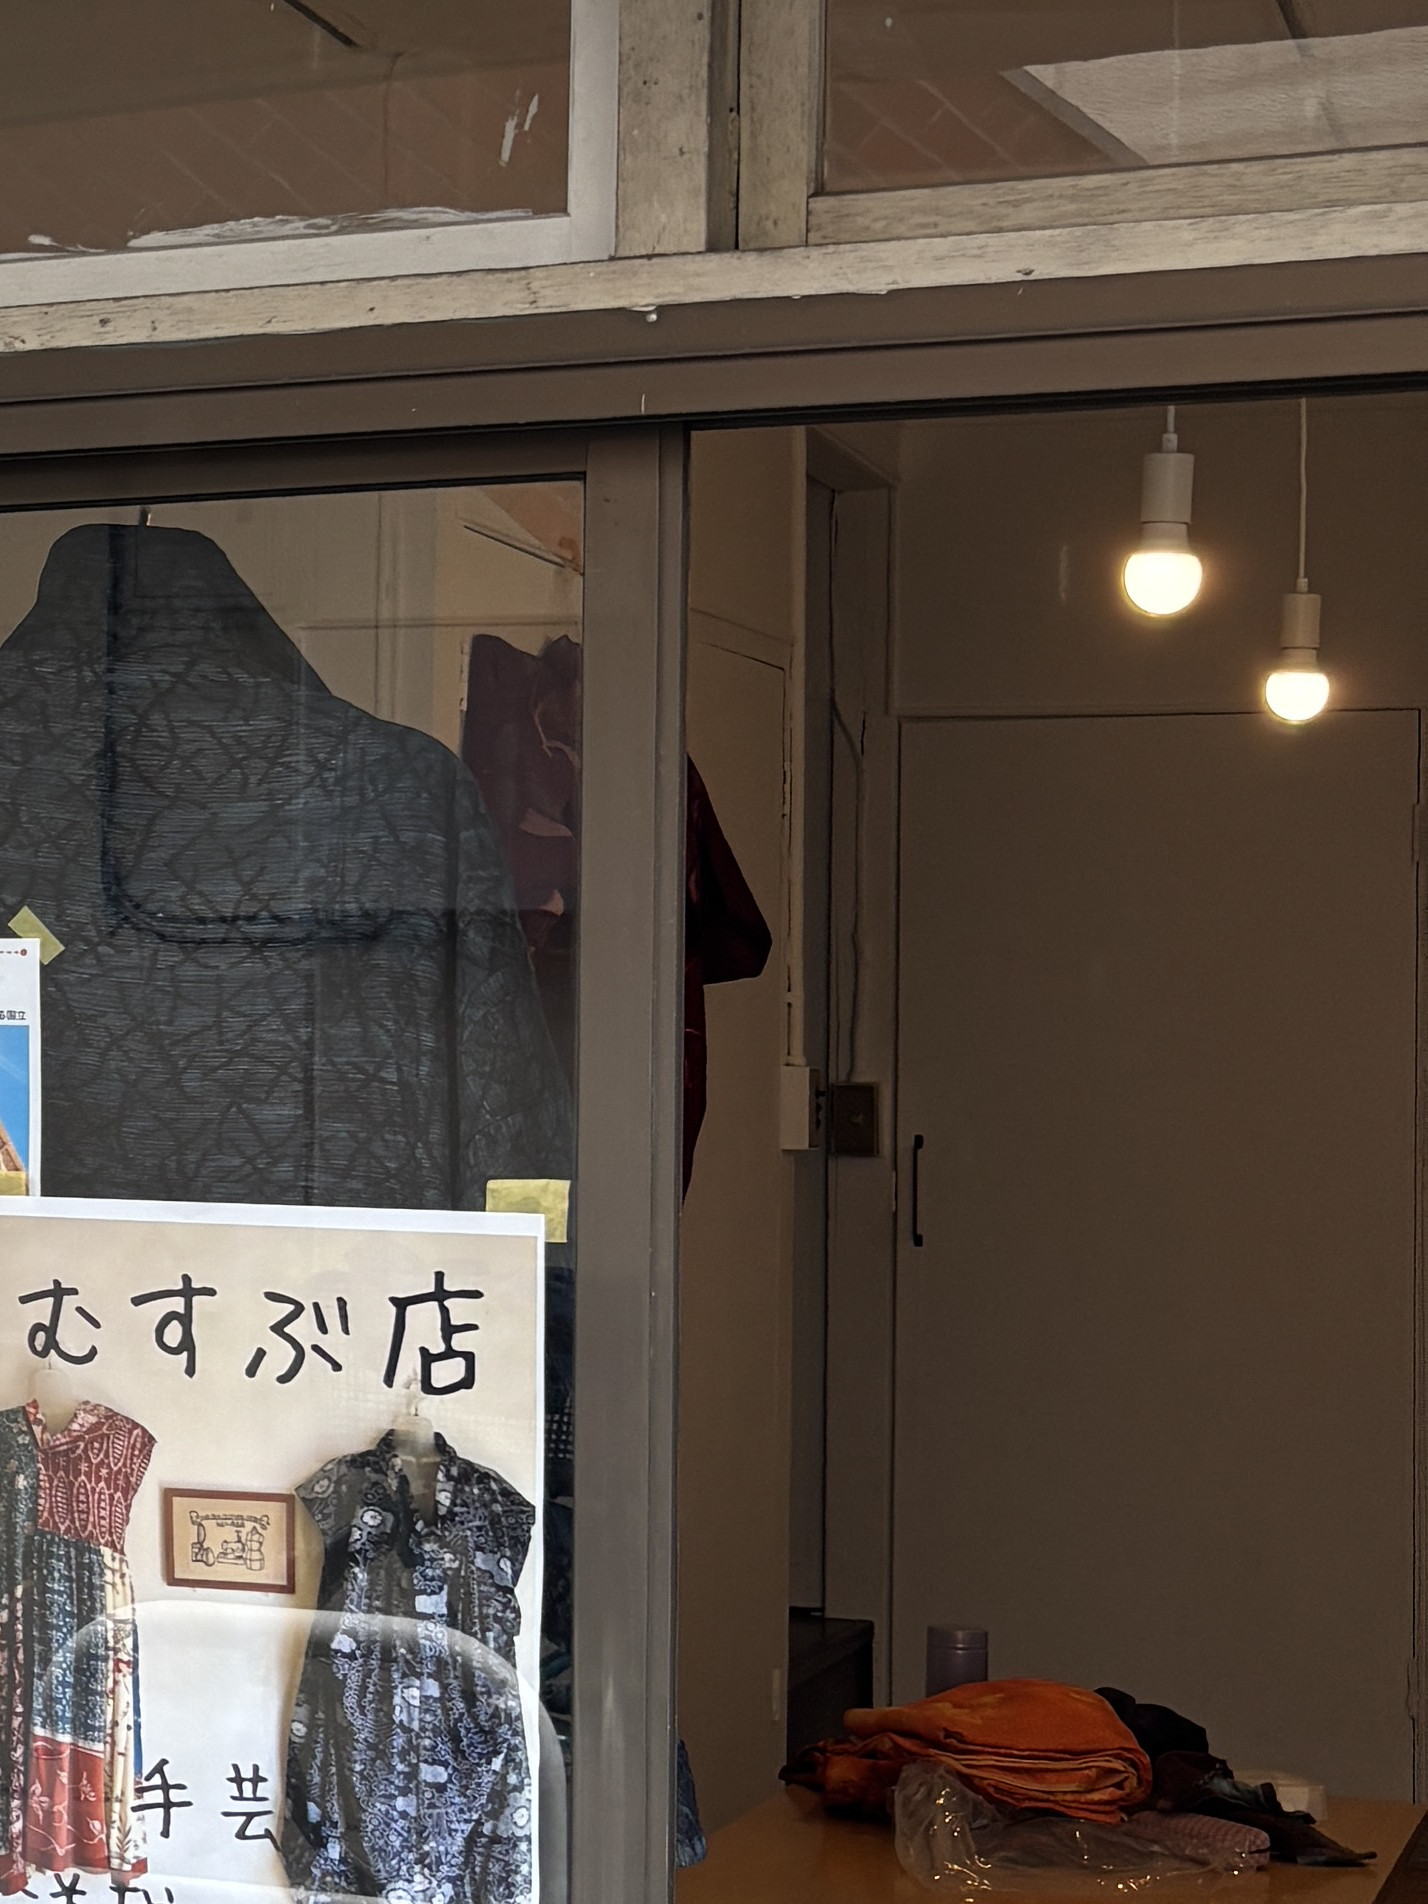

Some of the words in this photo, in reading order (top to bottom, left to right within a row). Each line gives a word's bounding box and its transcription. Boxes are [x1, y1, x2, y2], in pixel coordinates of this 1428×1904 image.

[16, 1268, 486, 1397] むすぶ店
[129, 1756, 282, 1853] 手芸
